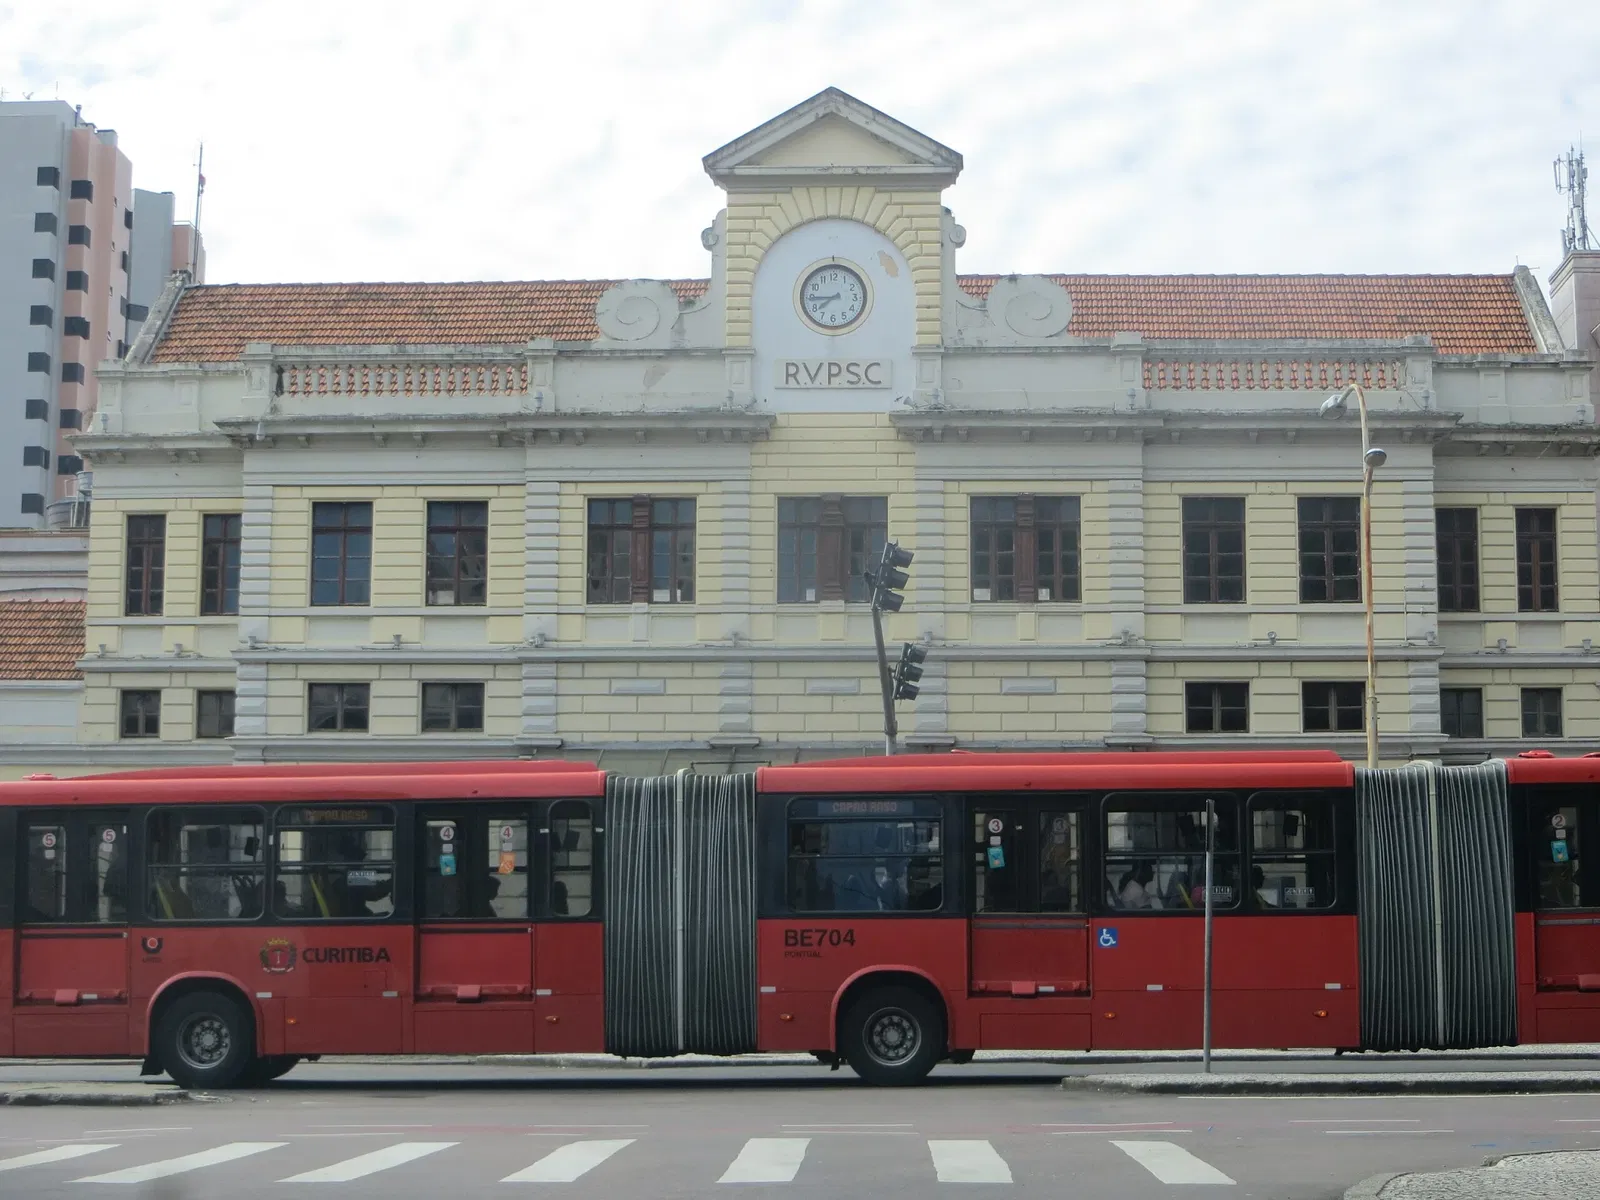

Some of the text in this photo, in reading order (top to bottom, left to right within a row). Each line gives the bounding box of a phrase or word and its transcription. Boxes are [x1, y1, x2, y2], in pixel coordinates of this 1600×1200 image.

[820, 275, 827, 284] 11
[829, 272, 838, 282] 12
[811, 283, 855, 291] 10 2
[852, 293, 858, 302] 3
[812, 304, 855, 312] 8 4
[820, 312, 847, 323] 7 6 5
[784, 929, 856, 947] BE704
[302, 946, 391, 963] CURITIBA
